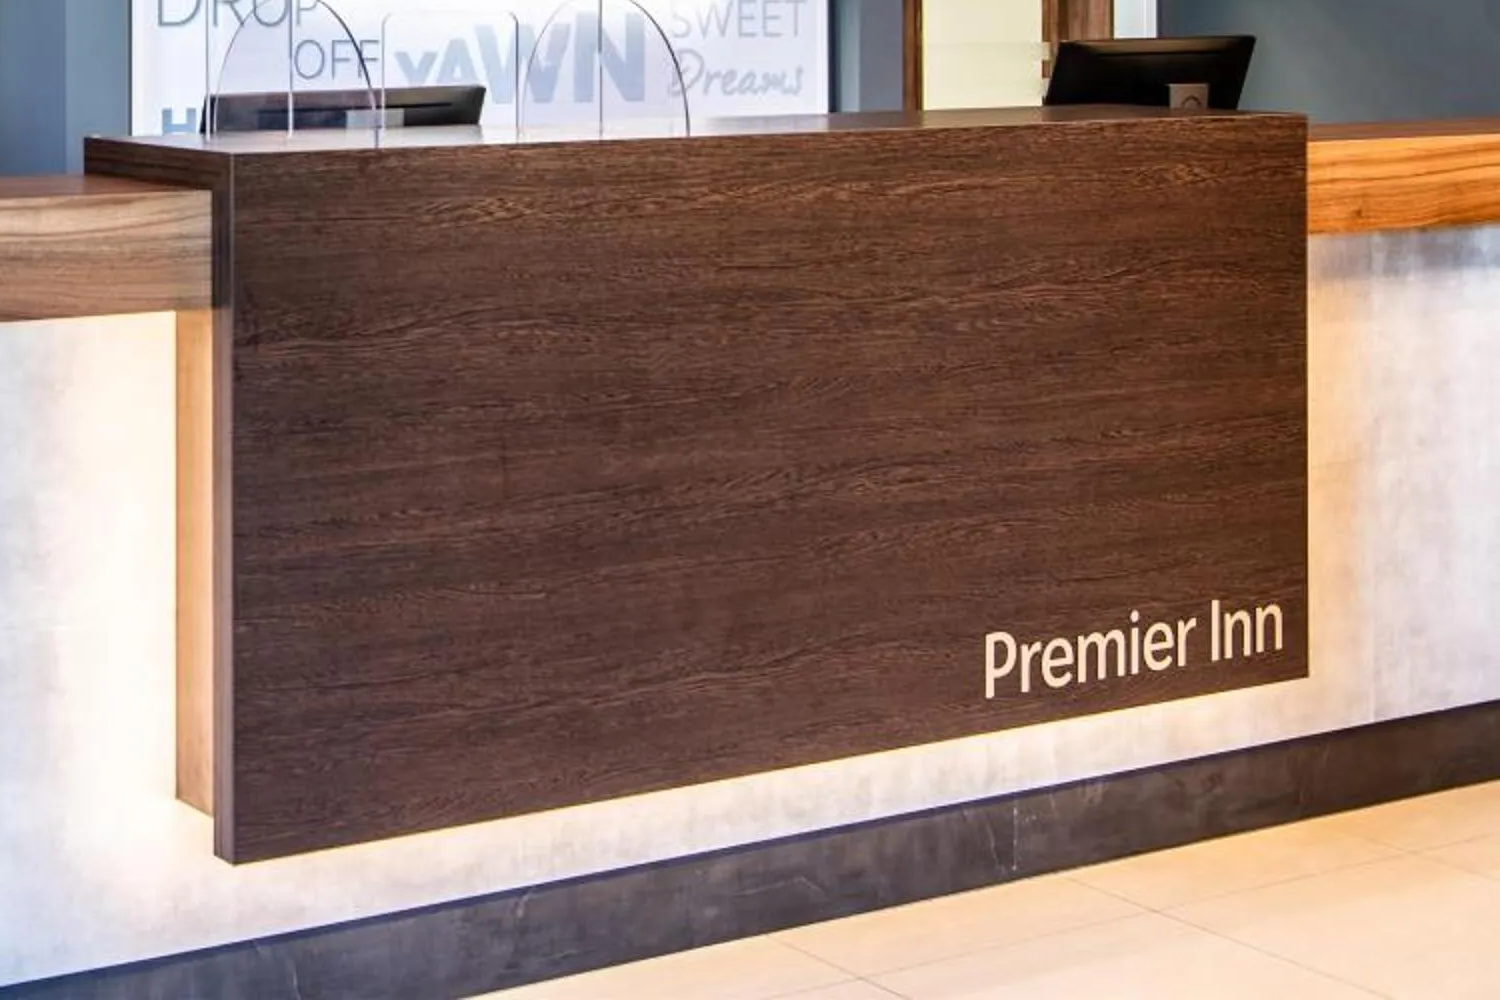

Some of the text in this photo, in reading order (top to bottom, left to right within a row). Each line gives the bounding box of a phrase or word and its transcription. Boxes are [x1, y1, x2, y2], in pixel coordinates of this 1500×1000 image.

[295, 39, 380, 79] OFF
[669, 47, 805, 98] Dreams
[985, 600, 1283, 698] Premier Inn
